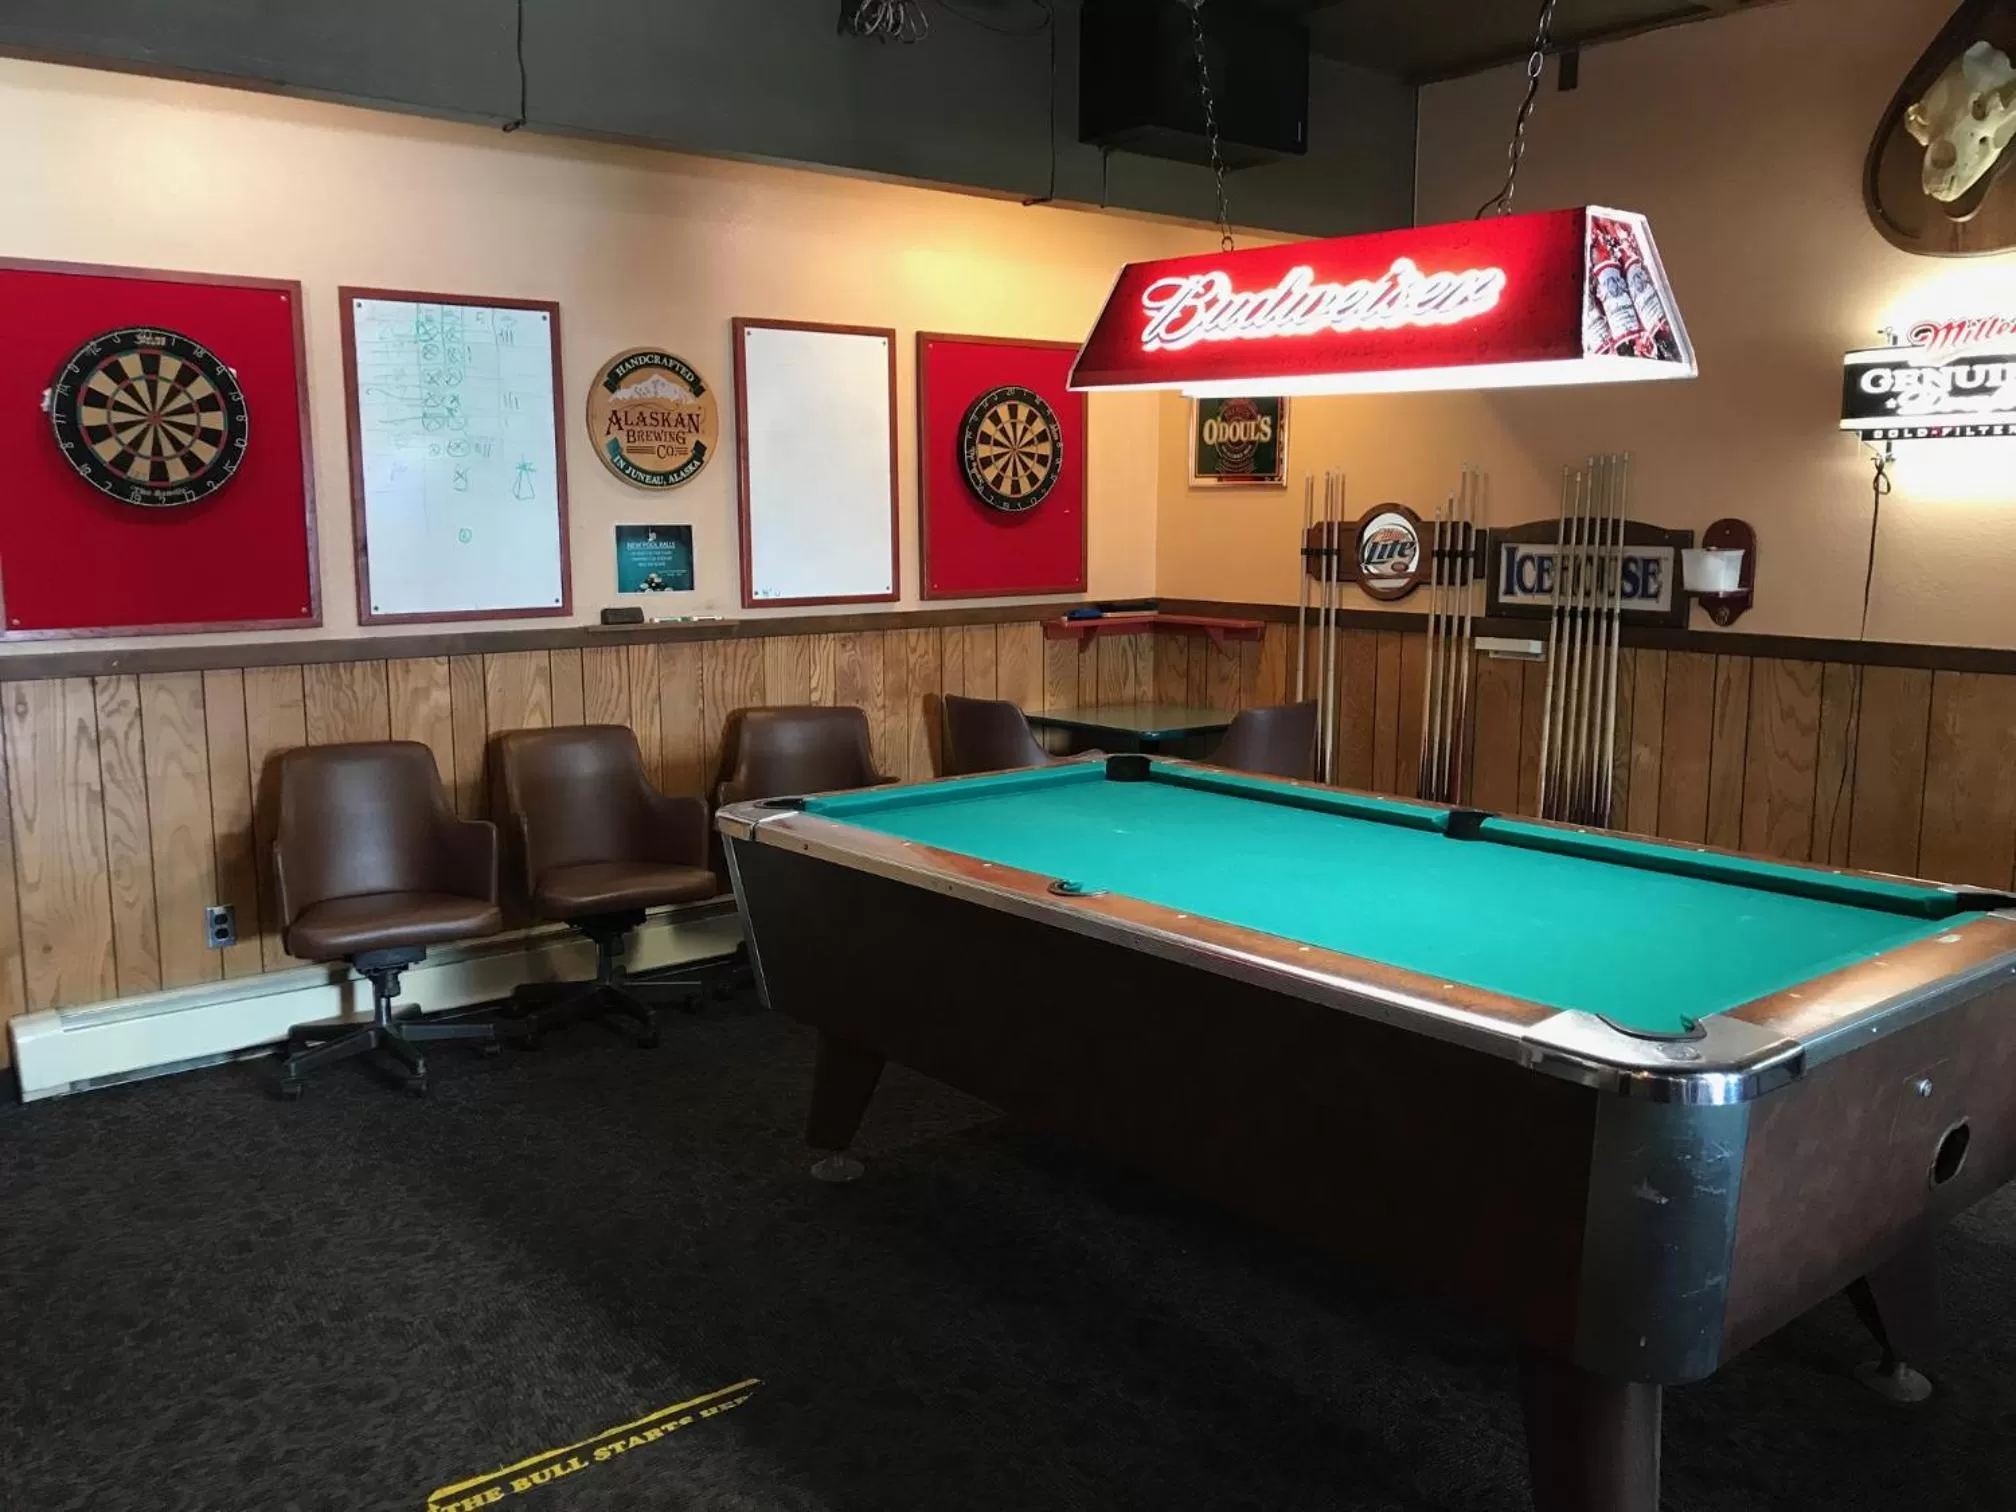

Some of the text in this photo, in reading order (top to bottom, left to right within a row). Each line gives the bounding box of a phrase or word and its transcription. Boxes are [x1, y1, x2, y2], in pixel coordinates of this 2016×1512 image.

[1142, 257, 1505, 351] Budweiser
[615, 354, 695, 382] HANDCRAFTED
[1861, 363, 2016, 393] GENUI
[606, 410, 700, 436] ALASKAN
[626, 429, 686, 445] BREWING
[613, 455, 701, 486] IN JUNEAU, ALASKA
[1364, 540, 1416, 565] Lite
[509, 1457, 590, 1493] BULL
